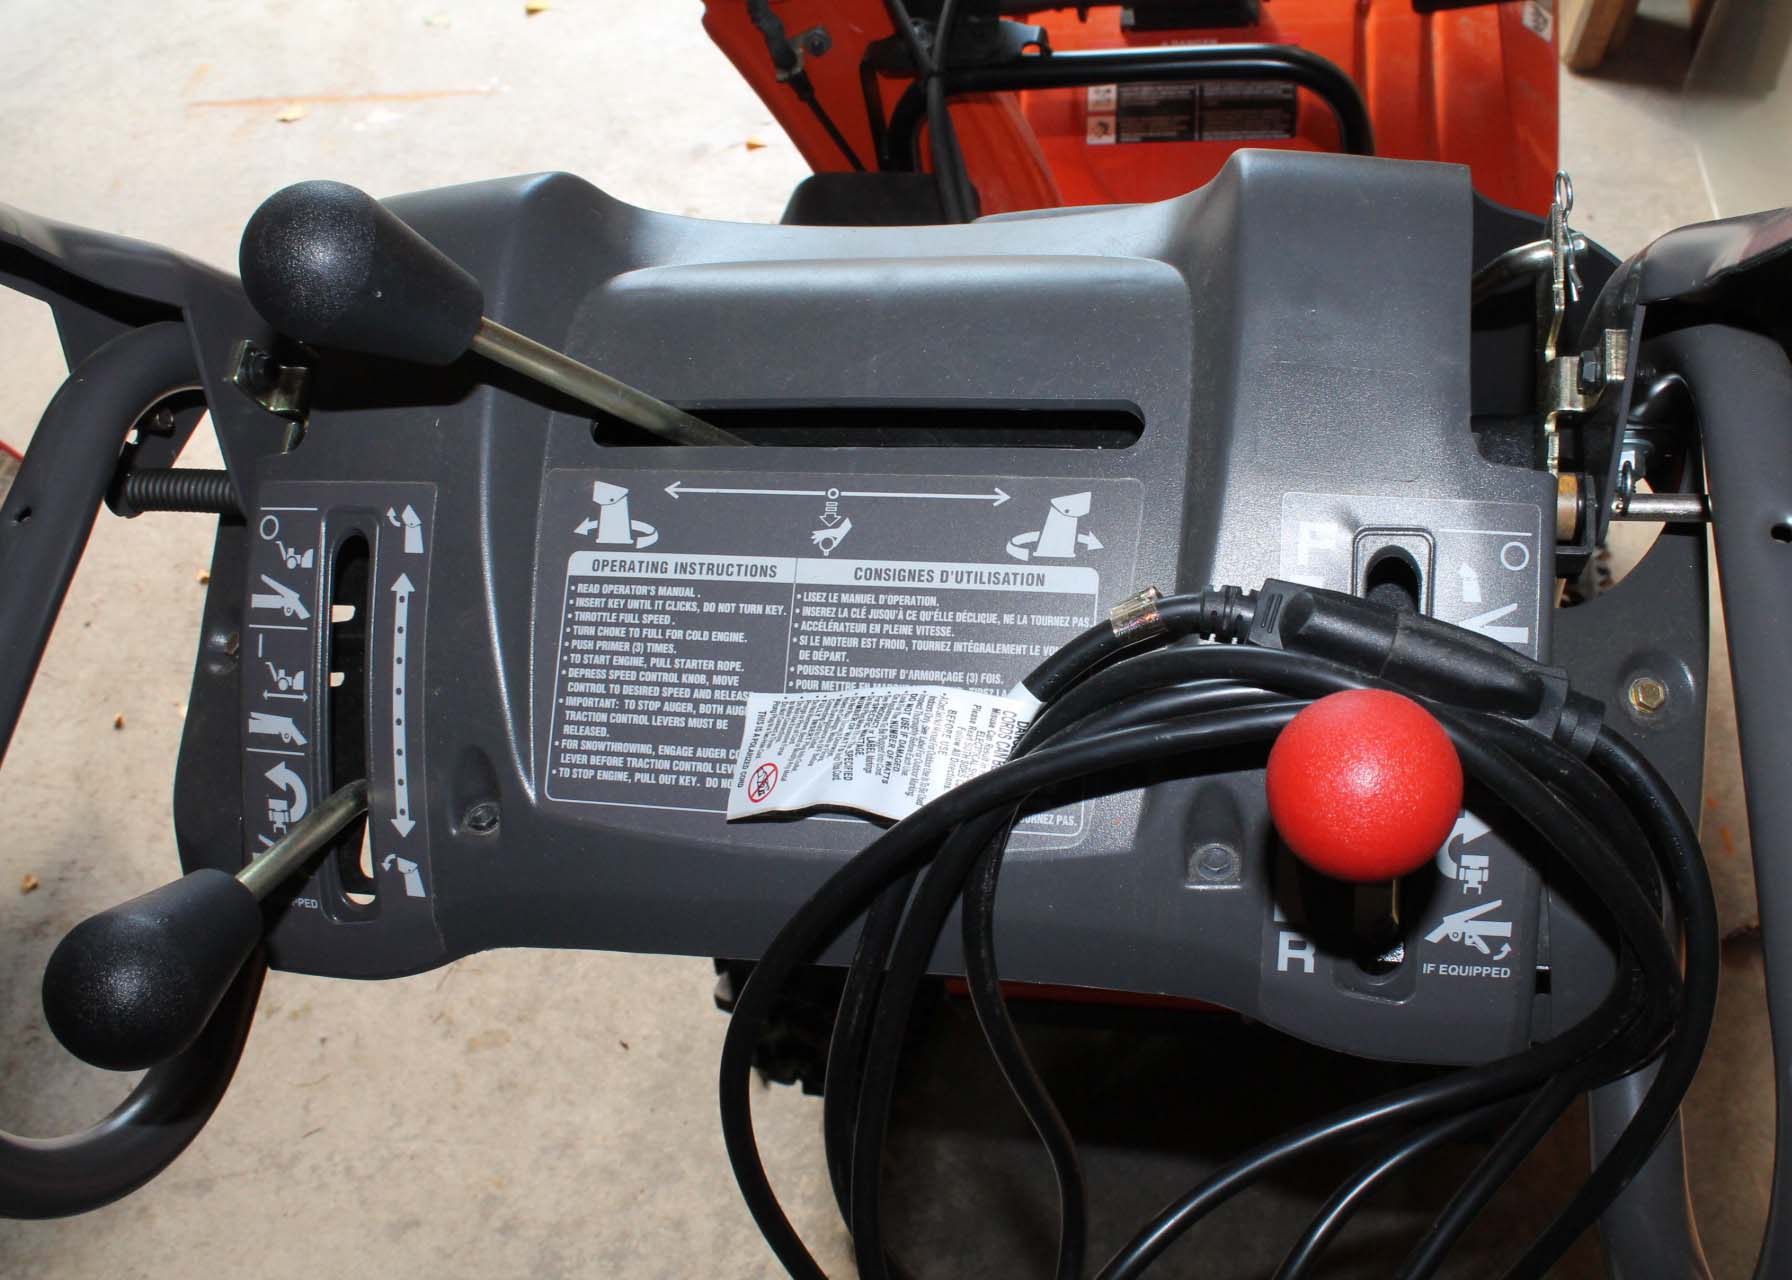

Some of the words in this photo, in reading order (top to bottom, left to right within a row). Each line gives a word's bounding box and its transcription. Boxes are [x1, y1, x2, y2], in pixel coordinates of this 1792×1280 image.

[592, 559, 668, 574] OPERATING
[674, 561, 776, 578] INSTRUCTIONS
[854, 567, 934, 582] CONSIGNES
[940, 570, 1045, 586] D'UTILISATION
[577, 583, 600, 593] READ
[602, 584, 656, 595] OPERATOR'S
[575, 597, 606, 607] INSERT
[607, 598, 625, 608] KEY
[627, 599, 652, 609] UNTIL
[654, 600, 664, 610] IT
[665, 600, 700, 613] CLICKS,
[703, 602, 716, 612] DO
[718, 602, 736, 613] NOT
[739, 603, 763, 614] TURN
[765, 604, 786, 615] KEY.
[803, 592, 826, 602] LISEZ
[828, 592, 838, 603] LE
[840, 593, 876, 604] MANUEL
[878, 594, 939, 606] D'OPERATION.
[574, 611, 617, 622] THROTTLE
[619, 613, 640, 623] FULL
[838, 607, 848, 617] LA
[850, 606, 866, 618] CLÉ
[868, 607, 903, 620] JUSQU'À
[906, 610, 917, 620] CE
[955, 610, 1000, 625] DÉCLIQUE,
[1003, 614, 1015, 624] NE
[1016, 614, 1027, 624] LA
[1030, 615, 1070, 627] TOURNEZ
[1072, 615, 1093, 627] PAS.
[573, 625, 595, 635] TURN
[597, 626, 626, 637] CHOKE
[628, 627, 640, 637] TO
[642, 628, 663, 638] FULL
[665, 629, 683, 639] FOR
[685, 630, 709, 640] COLD
[711, 631, 747, 642] ENGINE.
[800, 620, 866, 633] ACCÉLÉRATEUR
[869, 623, 881, 633] EN
[882, 624, 913, 635] PLEINE
[916, 625, 954, 636] VITESSE.
[571, 639, 594, 649] PUSH
[596, 640, 630, 651] PRIMER
[632, 642, 644, 654] (3)
[646, 642, 676, 653] TIMES.
[799, 635, 808, 645] SI
[809, 635, 820, 646] LE
[822, 636, 859, 647] MOTEUR
[861, 637, 877, 648] EST
[879, 638, 908, 651] FROID,
[912, 640, 951, 651] TOURNEZ
[953, 640, 1028, 655] INTÉGRALEMENT
[1029, 645, 1040, 655] LE
[570, 653, 581, 663] TO
[582, 654, 611, 665] START
[612, 655, 646, 668] ENGINE,
[650, 657, 671, 668] PULL
[673, 658, 714, 670] STARTER
[717, 660, 744, 671] ROPE.
[799, 650, 810, 660] DE
[812, 649, 849, 662] DÉPART.
[568, 667, 606, 679] DEPRESS
[608, 669, 636, 680] SPEED
[639, 671, 679, 683] CONTROL
[681, 673, 709, 686] KNOB,
[712, 675, 739, 686] MOVE
[797, 664, 835, 676] POUSSEZ
[837, 666, 847, 676] LE
[849, 667, 897, 679] DISPOSITIF
[899, 669, 964, 683] D'ARMORÇAGE
[966, 672, 978, 685] (3)
[980, 673, 1003, 684] FOIS.
[567, 682, 606, 693] CONTROL
[609, 684, 620, 694] TO
[622, 685, 659, 696] DESIRED
[661, 686, 690, 698] SPEED
[693, 688, 711, 699] AND
[796, 679, 819, 690] POUR
[565, 696, 619, 708] IMPORTANT:
[624, 699, 636, 709] TO
[637, 700, 661, 710] STOP
[663, 701, 696, 714] AUGER,
[699, 703, 723, 714] BOTH
[725, 703, 745, 714] AUG
[908, 694, 918, 702] DO
[756, 712, 766, 724] THIS
[904, 704, 914, 715] NOT
[970, 704, 982, 724] Please
[565, 710, 607, 722] TRACTION
[609, 713, 649, 725] CONTROL
[652, 715, 685, 727] LEVERS
[687, 717, 714, 728] MUST
[716, 719, 728, 729] BE
[900, 718, 910, 730] USE
[943, 710, 957, 739] BEFORE
[1000, 710, 1016, 740] CORDS
[563, 724, 609, 736] RELEASED.
[888, 720, 898, 748] NUMBER
[561, 739, 578, 749] FOR
[580, 740, 655, 755] SNOWTHROWING,
[658, 745, 693, 756] ENGAGE
[696, 747, 726, 758] AUGER
[729, 748, 740, 760] CO
[886, 750, 894, 759] OF
[938, 741, 950, 756] USE
[993, 741, 1010, 758] CAN
[560, 753, 587, 764] LEVER
[589, 755, 624, 766] BEFORE
[626, 757, 670, 769] TRACTION
[672, 760, 713, 772] CONTROL
[844, 750, 854, 781] SPECIFIED
[558, 767, 570, 777] TO
[571, 768, 594, 779] STOP
[597, 770, 631, 783] ENGINE,
[634, 772, 656, 783] PULL
[658, 774, 677, 784] OUT
[679, 775, 700, 786] KEY.
[705, 777, 718, 788] DO
[721, 777, 732, 788] NO
[738, 771, 748, 788] CORD
[882, 761, 892, 784] WATTS
[1056, 815, 1078, 826] PAS.
[1278, 931, 1316, 973] R
[1423, 963, 1436, 976] IF
[1438, 964, 1511, 978] EQUIPPED
